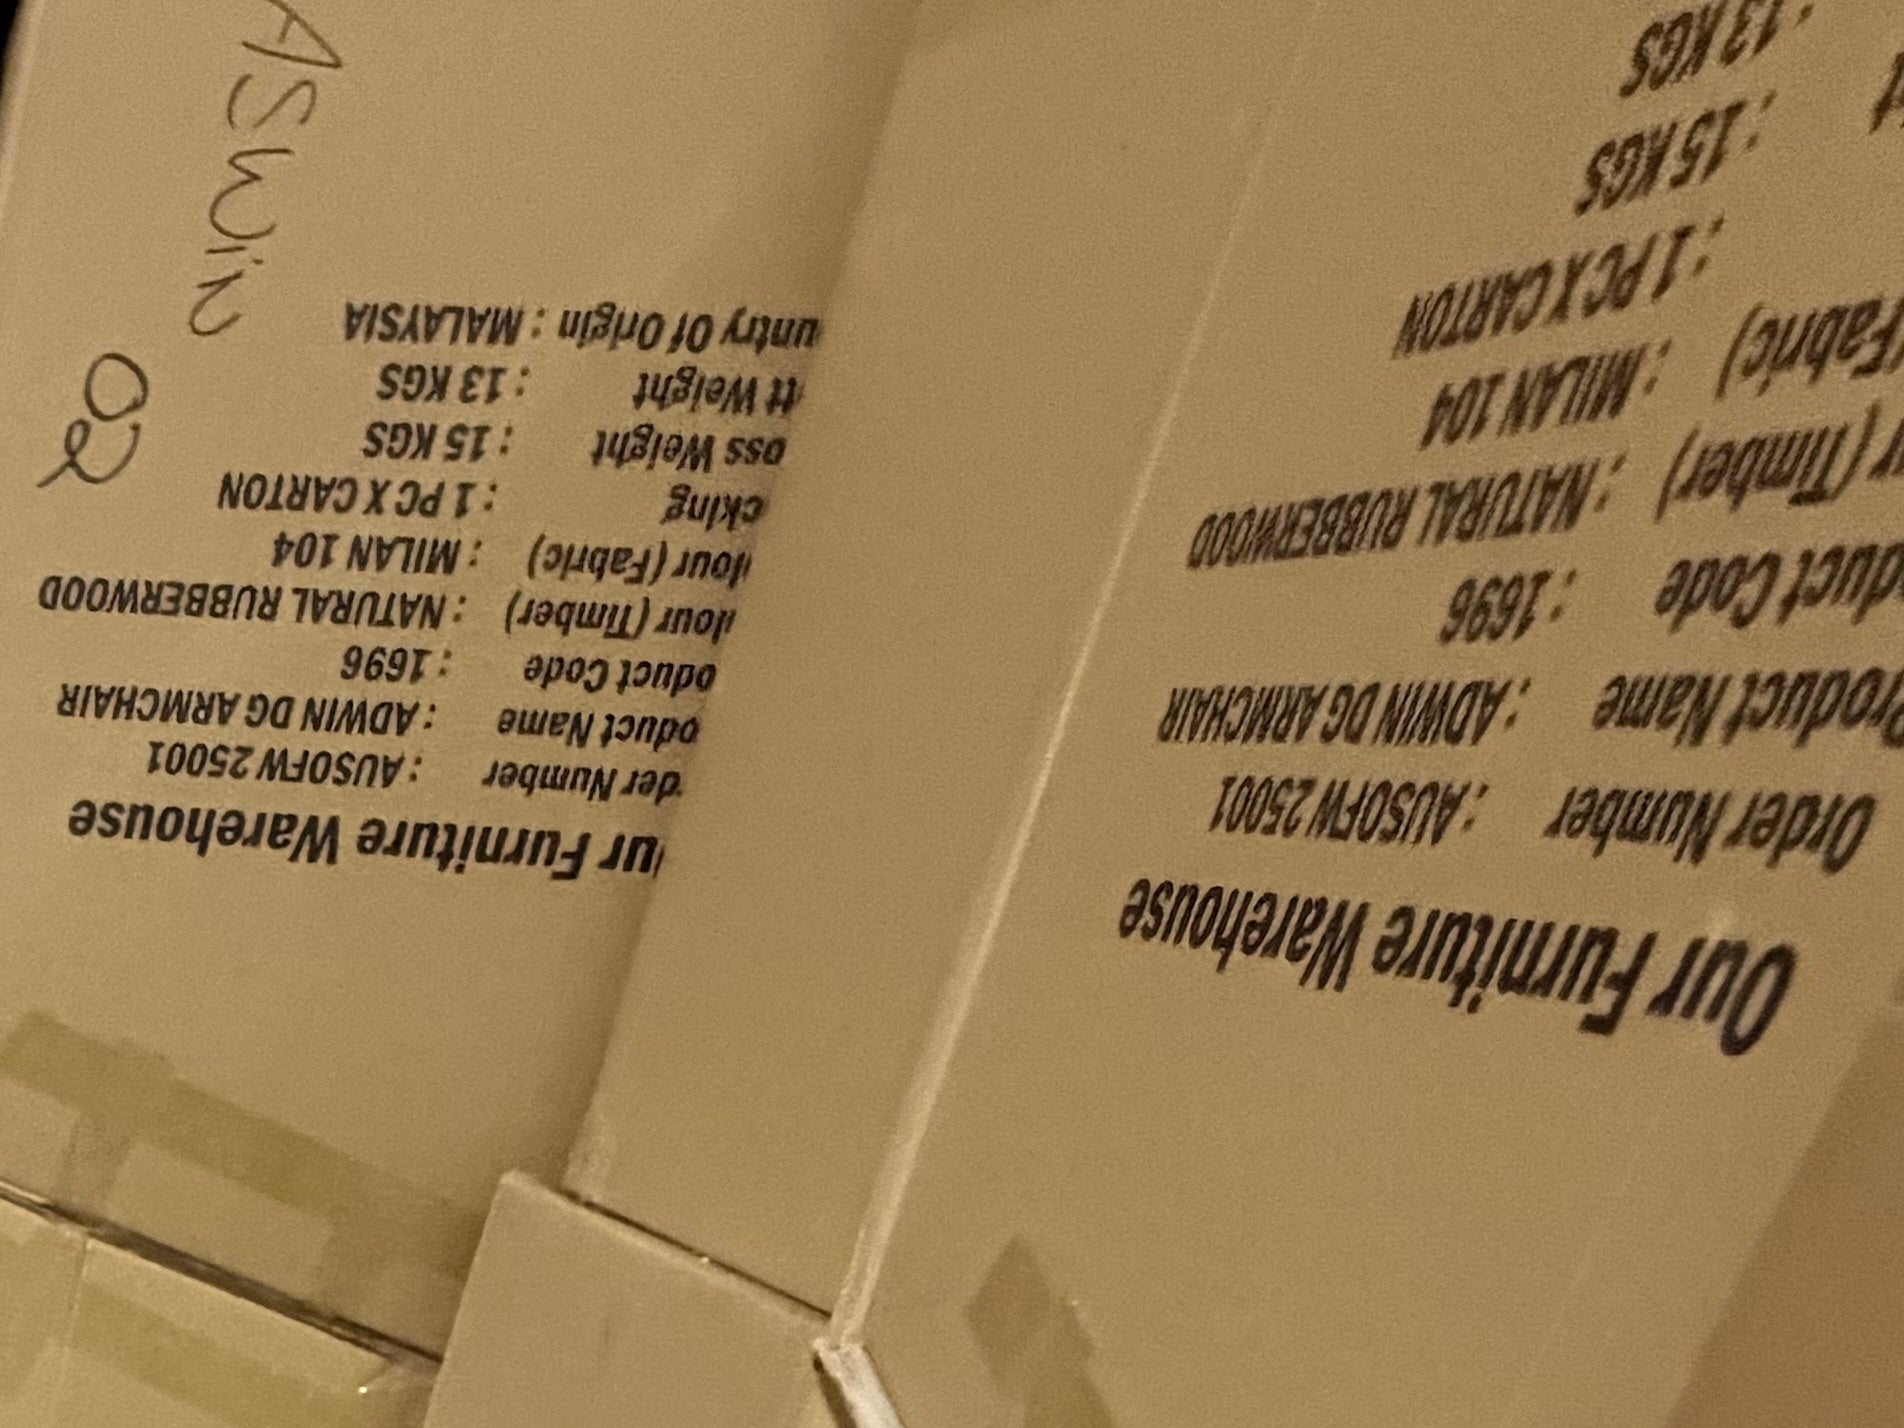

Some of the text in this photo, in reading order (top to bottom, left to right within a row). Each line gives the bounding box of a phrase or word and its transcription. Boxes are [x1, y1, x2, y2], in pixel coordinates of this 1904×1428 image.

[376, 362, 507, 404] 13 KGS
[1191, 405, 1877, 567] (Timber) NATURAL RUBBERWOOD
[271, 532, 668, 585] (Fabric) MILAN 104
[69, 801, 341, 865] Warehouse
[356, 818, 592, 881] Furniture
[1212, 777, 1874, 871] Order Number AUSOFW 25001
[1122, 881, 1797, 1053] Our Furniture Warehouse
